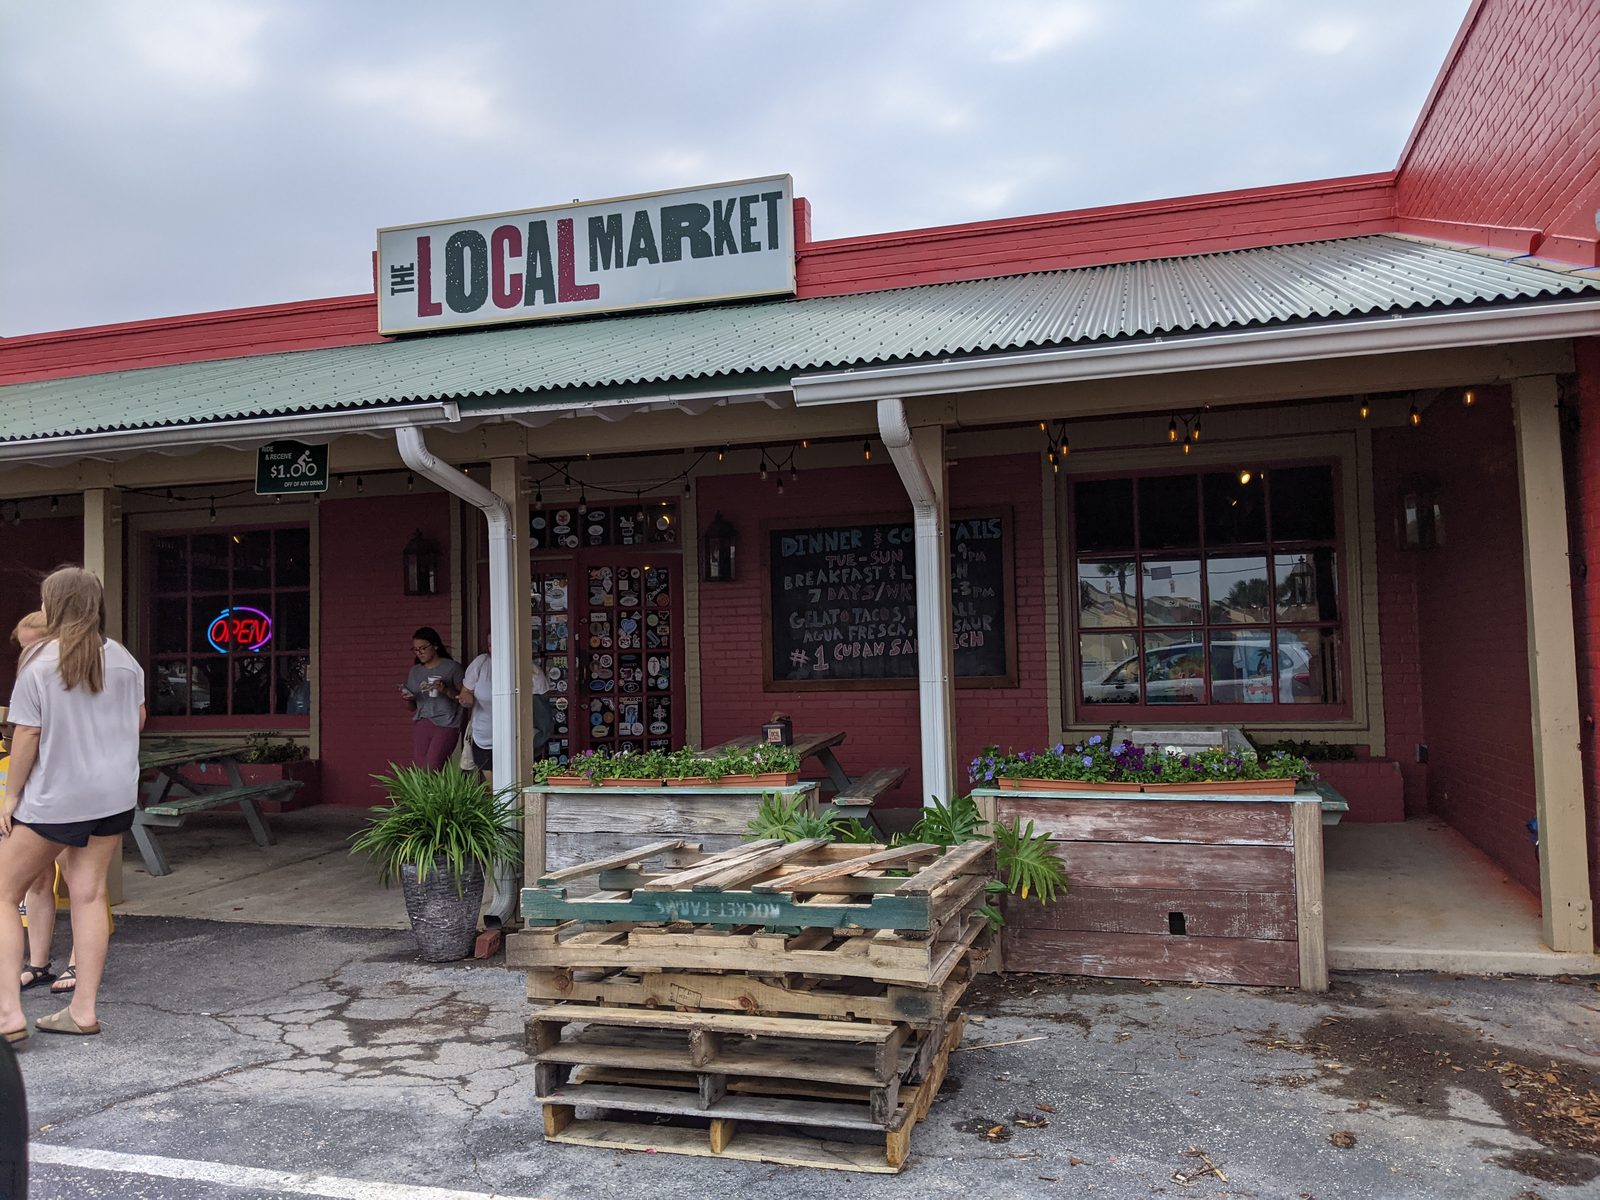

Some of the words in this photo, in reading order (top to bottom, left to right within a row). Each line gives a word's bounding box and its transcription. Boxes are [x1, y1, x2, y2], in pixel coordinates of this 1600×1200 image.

[391, 263, 414, 296] THE
[417, 218, 600, 317] LOCAL
[588, 191, 783, 272] MARKET
[781, 528, 863, 558] DINNER
[783, 566, 883, 590] BREAKFAST
[808, 588, 822, 603] 7
[211, 619, 268, 643] OPEN
[803, 628, 844, 644] AGUA
[833, 641, 886, 661] CUBAN
